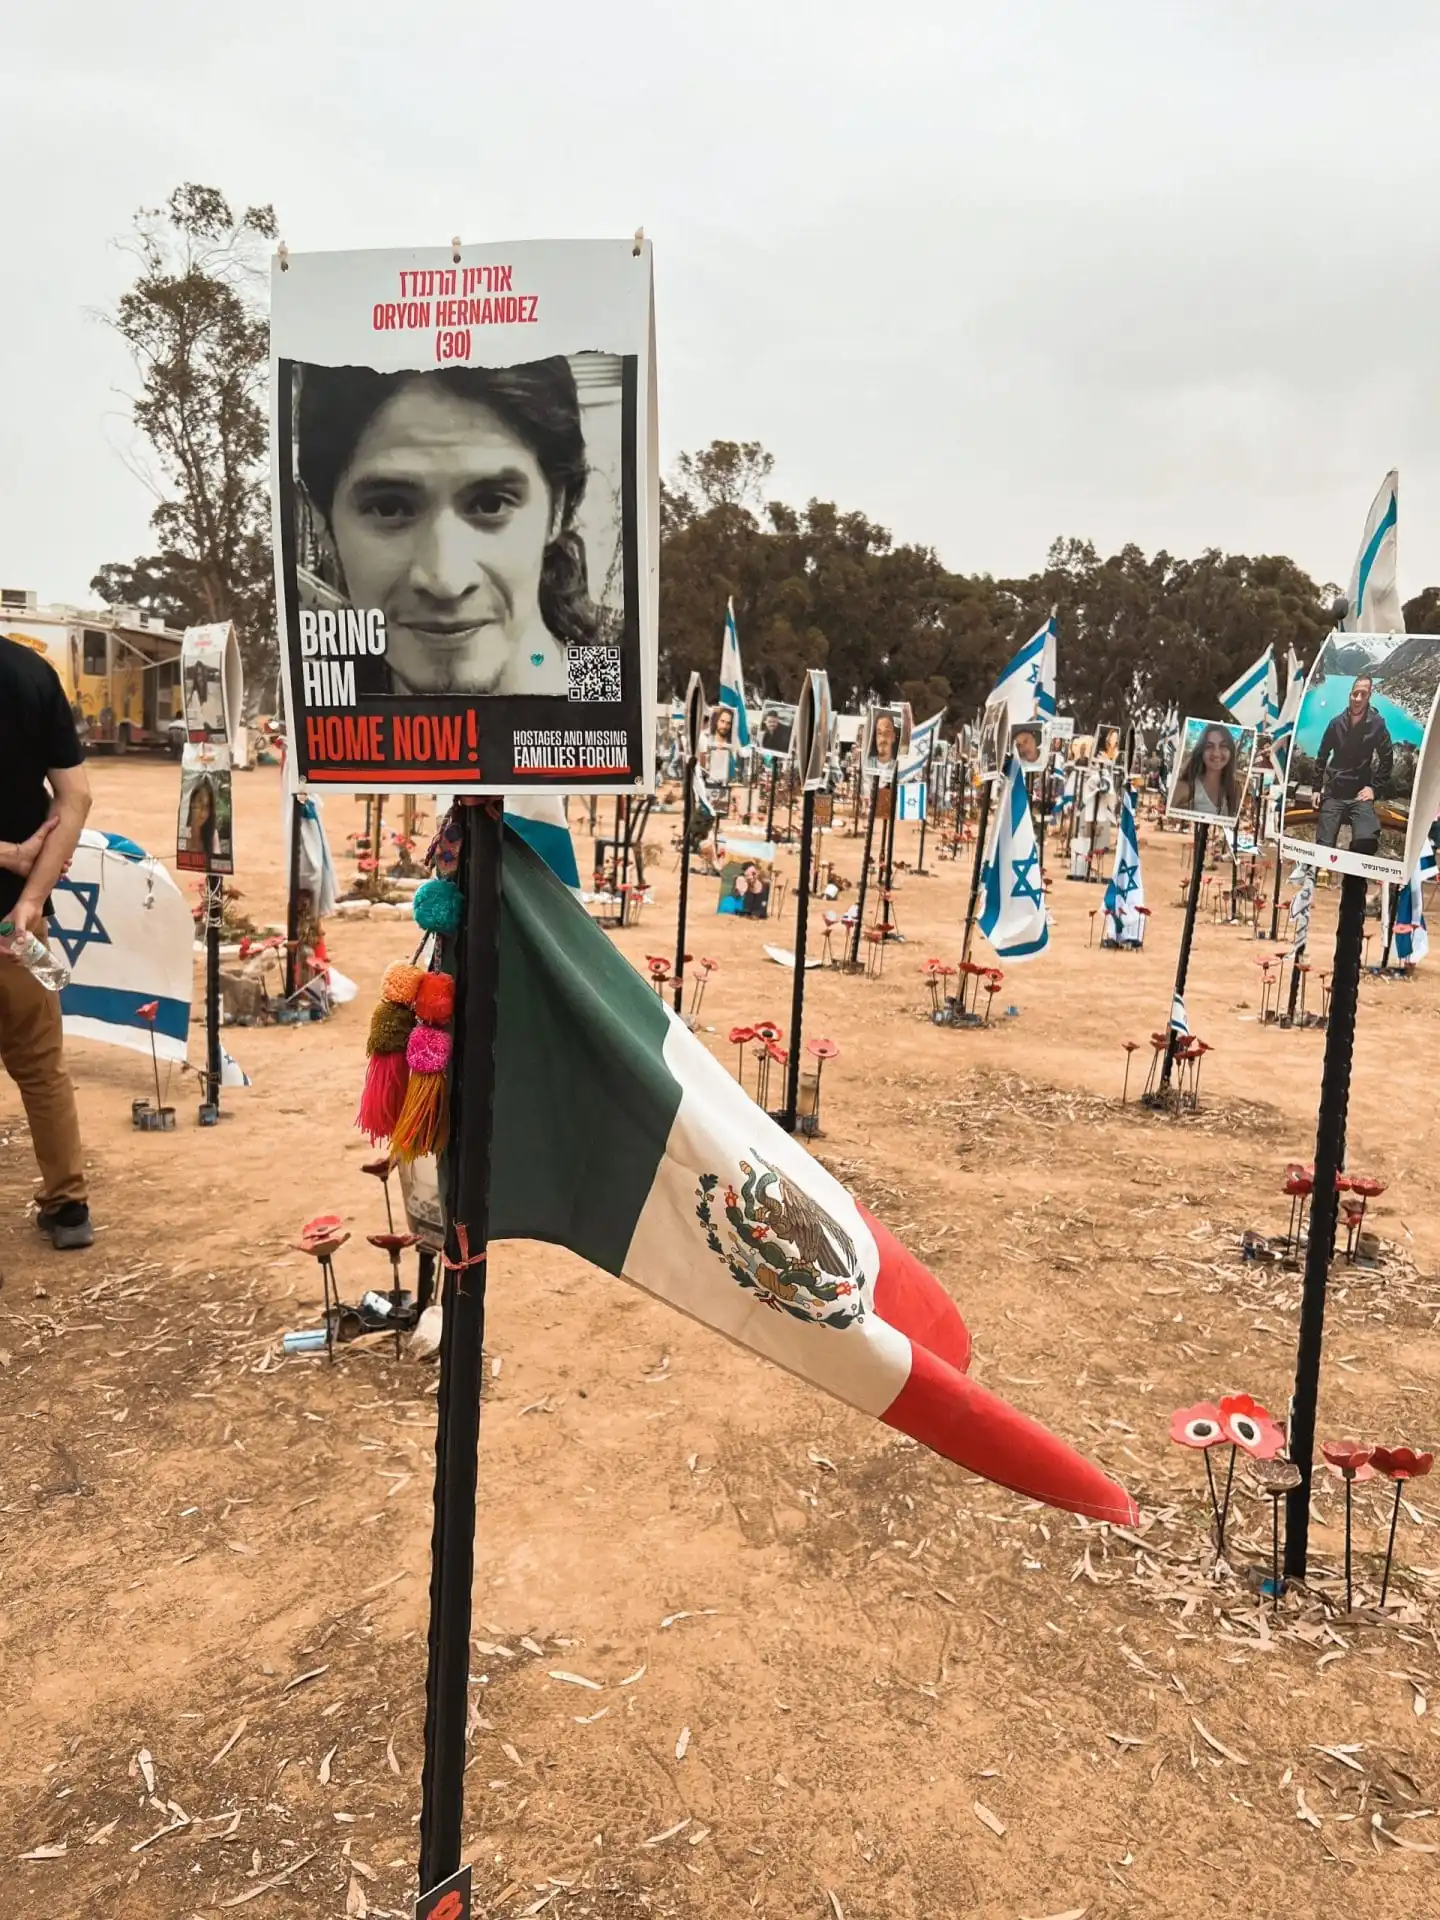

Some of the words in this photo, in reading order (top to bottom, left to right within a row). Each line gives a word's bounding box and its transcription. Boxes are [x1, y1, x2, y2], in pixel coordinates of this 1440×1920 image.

[399, 269, 457, 298] הרננדז
[462, 265, 512, 297] אוריון
[373, 301, 431, 331] ORYON
[436, 296, 539, 328] HERNANDEZ
[436, 329, 471, 362] (30)
[299, 608, 386, 656] BRING
[302, 660, 357, 707] HIM
[306, 716, 386, 761] HOME
[393, 708, 479, 762] NOW!
[513, 730, 562, 746] HOSTAGES
[563, 730, 583, 746] AND
[584, 730, 627, 746] MISSING
[514, 747, 576, 768] FAMILIES
[579, 747, 628, 768] FORUM
